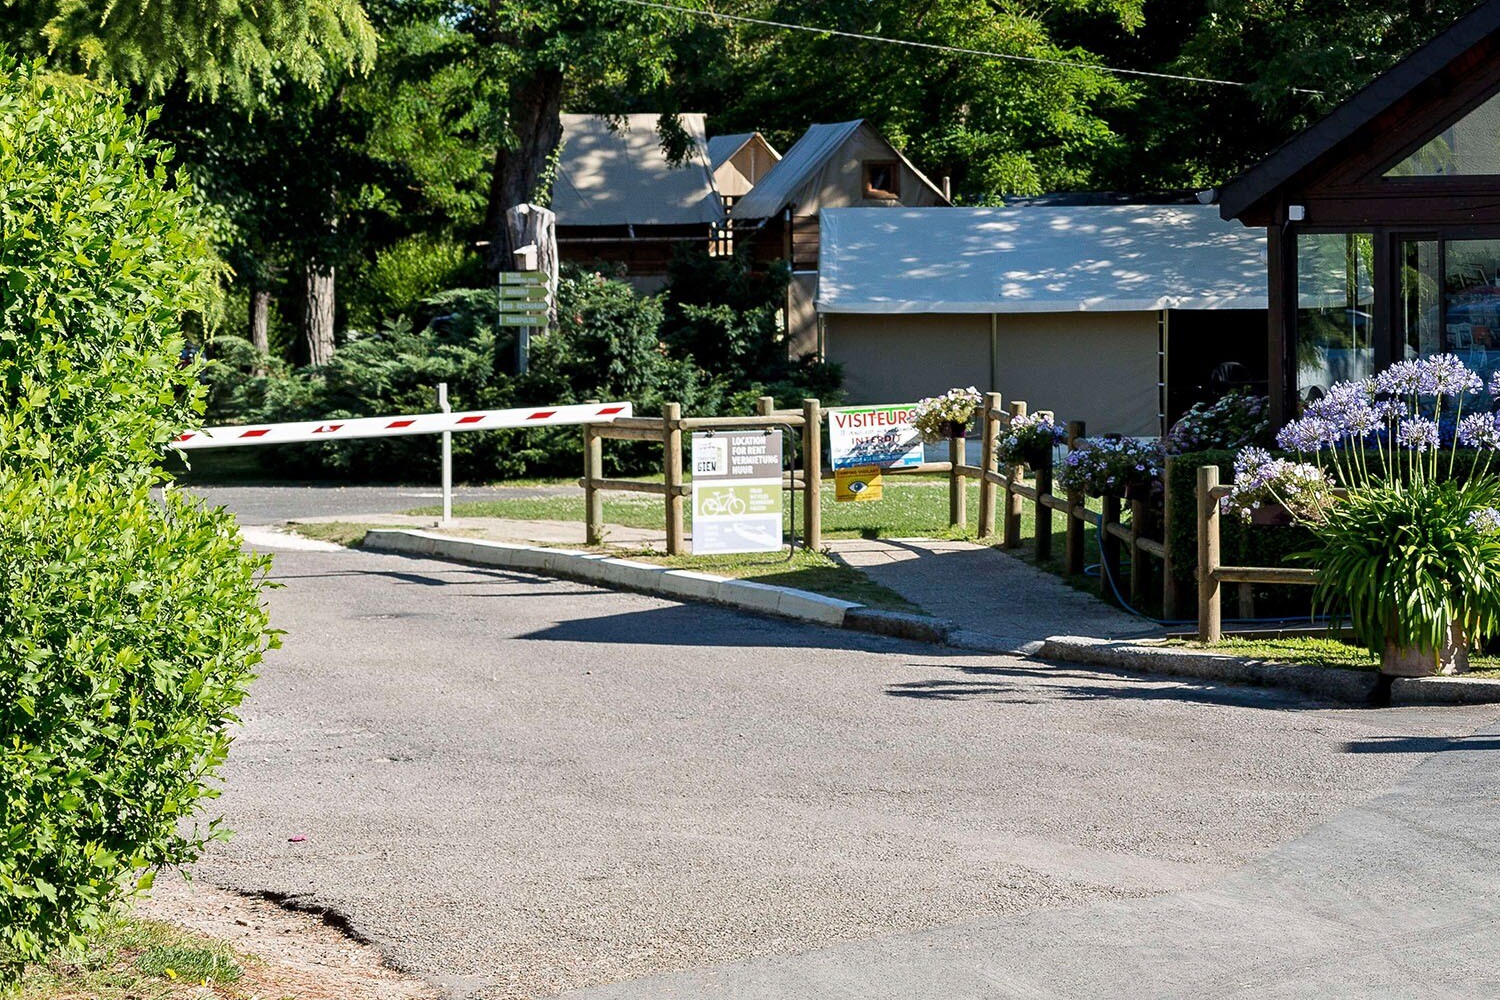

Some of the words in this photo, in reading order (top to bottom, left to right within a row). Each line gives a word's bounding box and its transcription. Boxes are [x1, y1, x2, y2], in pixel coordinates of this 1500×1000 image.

[835, 409, 917, 429] VISITEURS
[731, 436, 767, 446] LOCATION
[852, 433, 901, 445] INTERDIT
[732, 446, 746, 456] FOR
[747, 446, 767, 455] RENT
[731, 455, 779, 465] VERMIETUNG
[697, 461, 717, 472] GIEN
